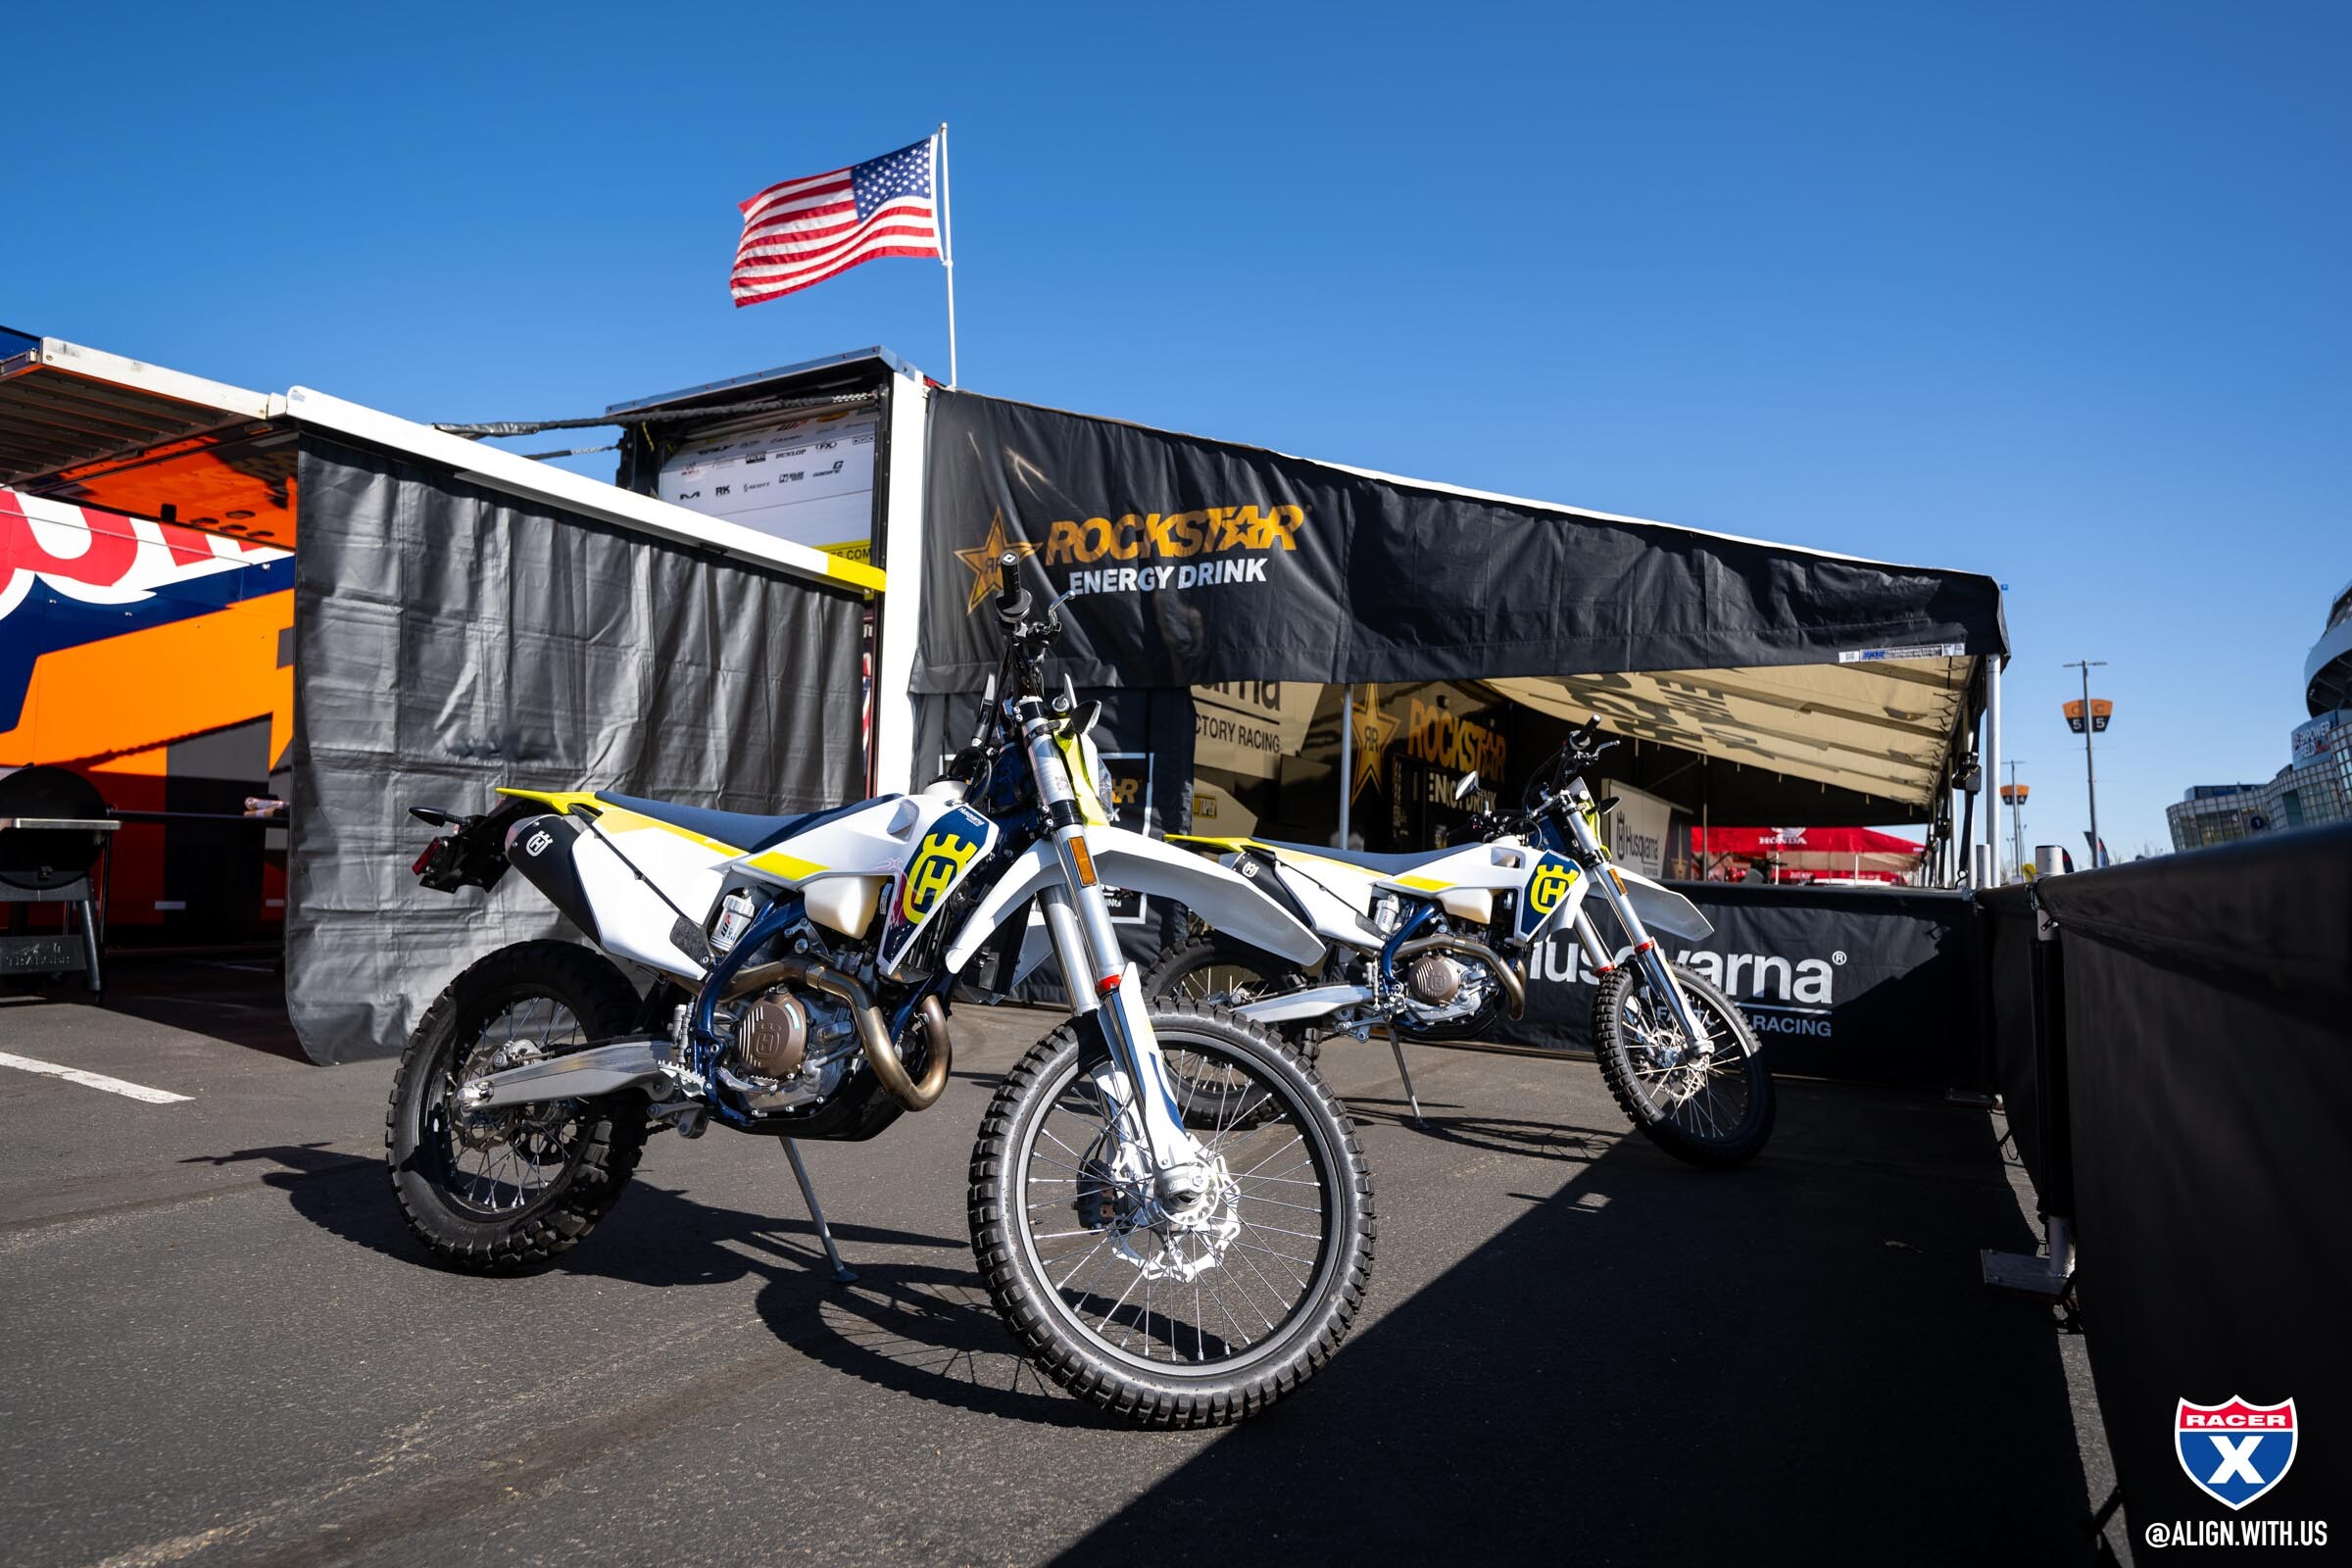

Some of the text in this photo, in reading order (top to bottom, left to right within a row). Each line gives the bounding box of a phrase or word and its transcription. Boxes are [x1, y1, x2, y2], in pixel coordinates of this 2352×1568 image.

[775, 449, 807, 460] DUNLOP
[714, 485, 731, 497] RK
[1046, 505, 1305, 566] ROCKSTAR
[1069, 558, 1268, 595] ENERGY DRINK
[2073, 718, 2082, 730] 5
[2095, 717, 2106, 729] 5
[1238, 725, 1280, 754] RACING
[1407, 698, 1506, 782] ROCKSTAR
[1758, 836, 1807, 845] HONDA
[1752, 1014, 1832, 1037] RACING
